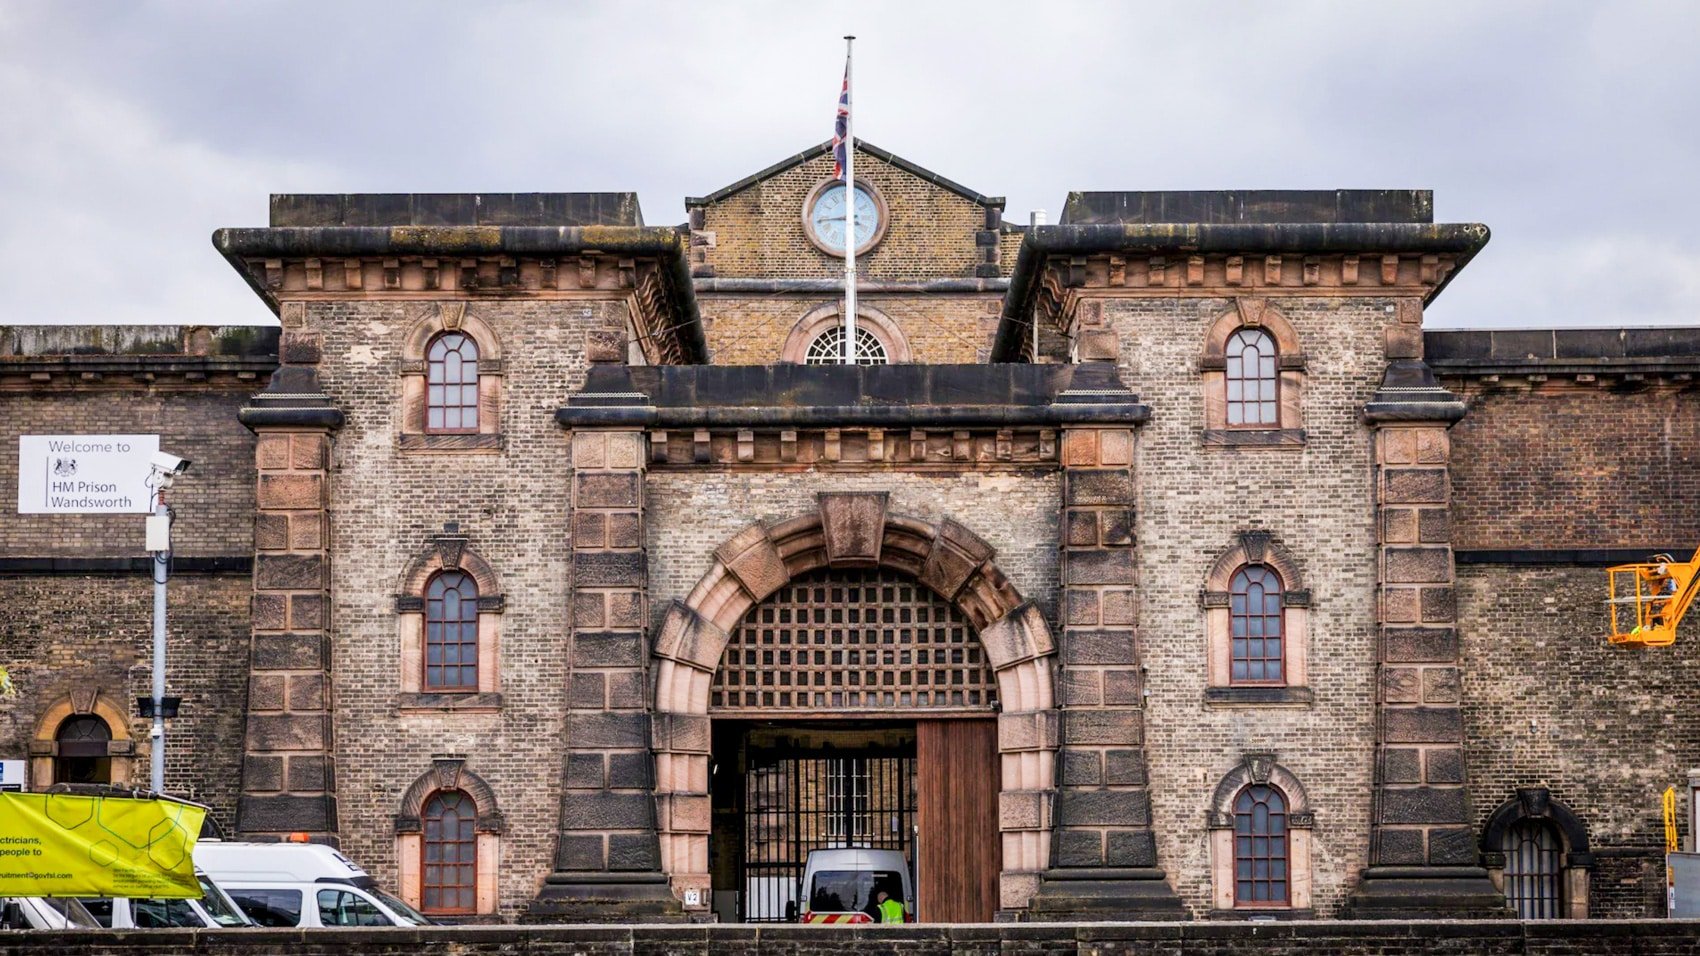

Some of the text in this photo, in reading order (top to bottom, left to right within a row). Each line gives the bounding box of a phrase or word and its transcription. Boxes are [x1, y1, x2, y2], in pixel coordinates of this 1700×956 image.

[49, 440, 131, 452] Welcome to
[52, 481, 117, 492] HM Prison
[51, 496, 132, 508] Wandsworth
[0, 848, 30, 857] people
